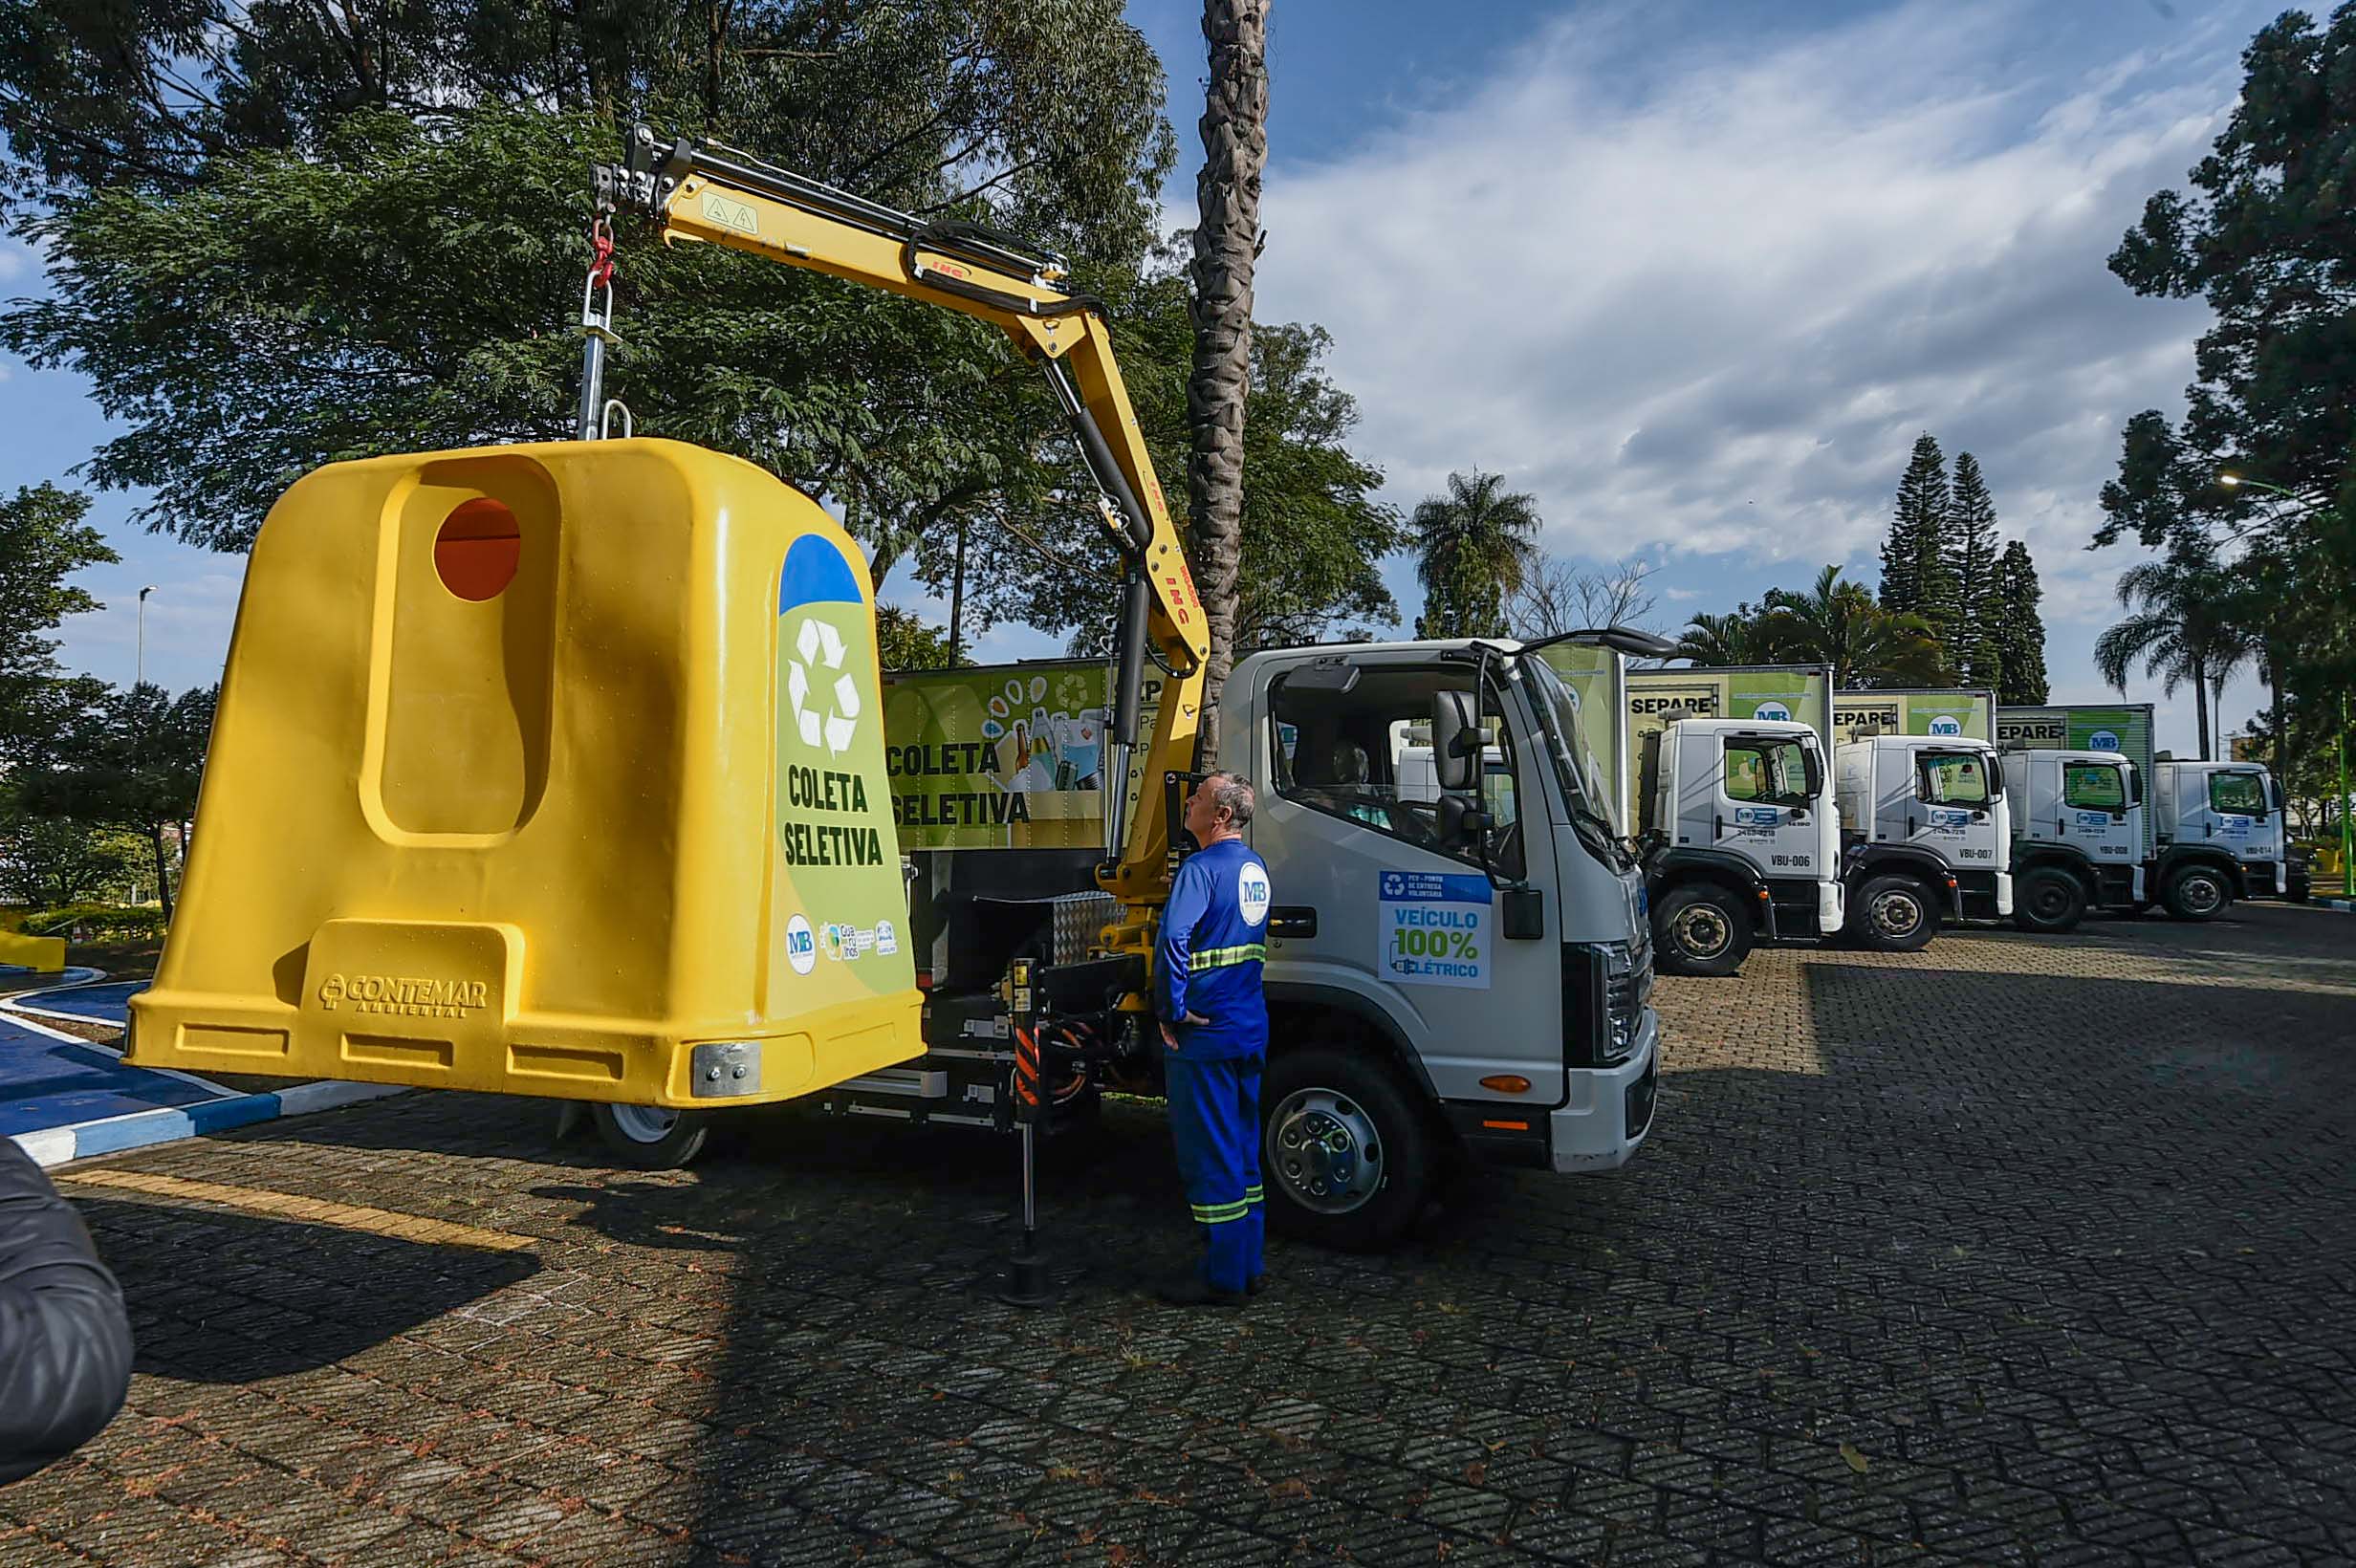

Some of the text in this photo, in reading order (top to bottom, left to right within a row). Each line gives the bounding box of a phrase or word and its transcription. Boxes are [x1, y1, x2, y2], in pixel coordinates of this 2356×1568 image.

[1166, 577, 1189, 625] ING
[1631, 698, 1712, 714] SEPARE
[1833, 711, 1892, 726] EPARE
[1931, 723, 1957, 735] MB
[1997, 725, 2060, 740] EPARE
[2092, 737, 2116, 750] MB
[886, 742, 1001, 776] COLETA
[788, 764, 868, 813] COLETA
[785, 822, 884, 866] SELETIVA
[1959, 848, 1993, 859] VBU-007
[1771, 855, 1810, 867] VBU-006
[1243, 882, 1267, 903] MB
[1394, 906, 1478, 928] VEÍCULO
[788, 930, 813, 955] MB
[1394, 928, 1478, 960] 100%
[1407, 959, 1478, 978] ELÉTRICO
[346, 975, 487, 1009] CONTEMAR
[357, 1001, 468, 1018] AMBIENTAL
